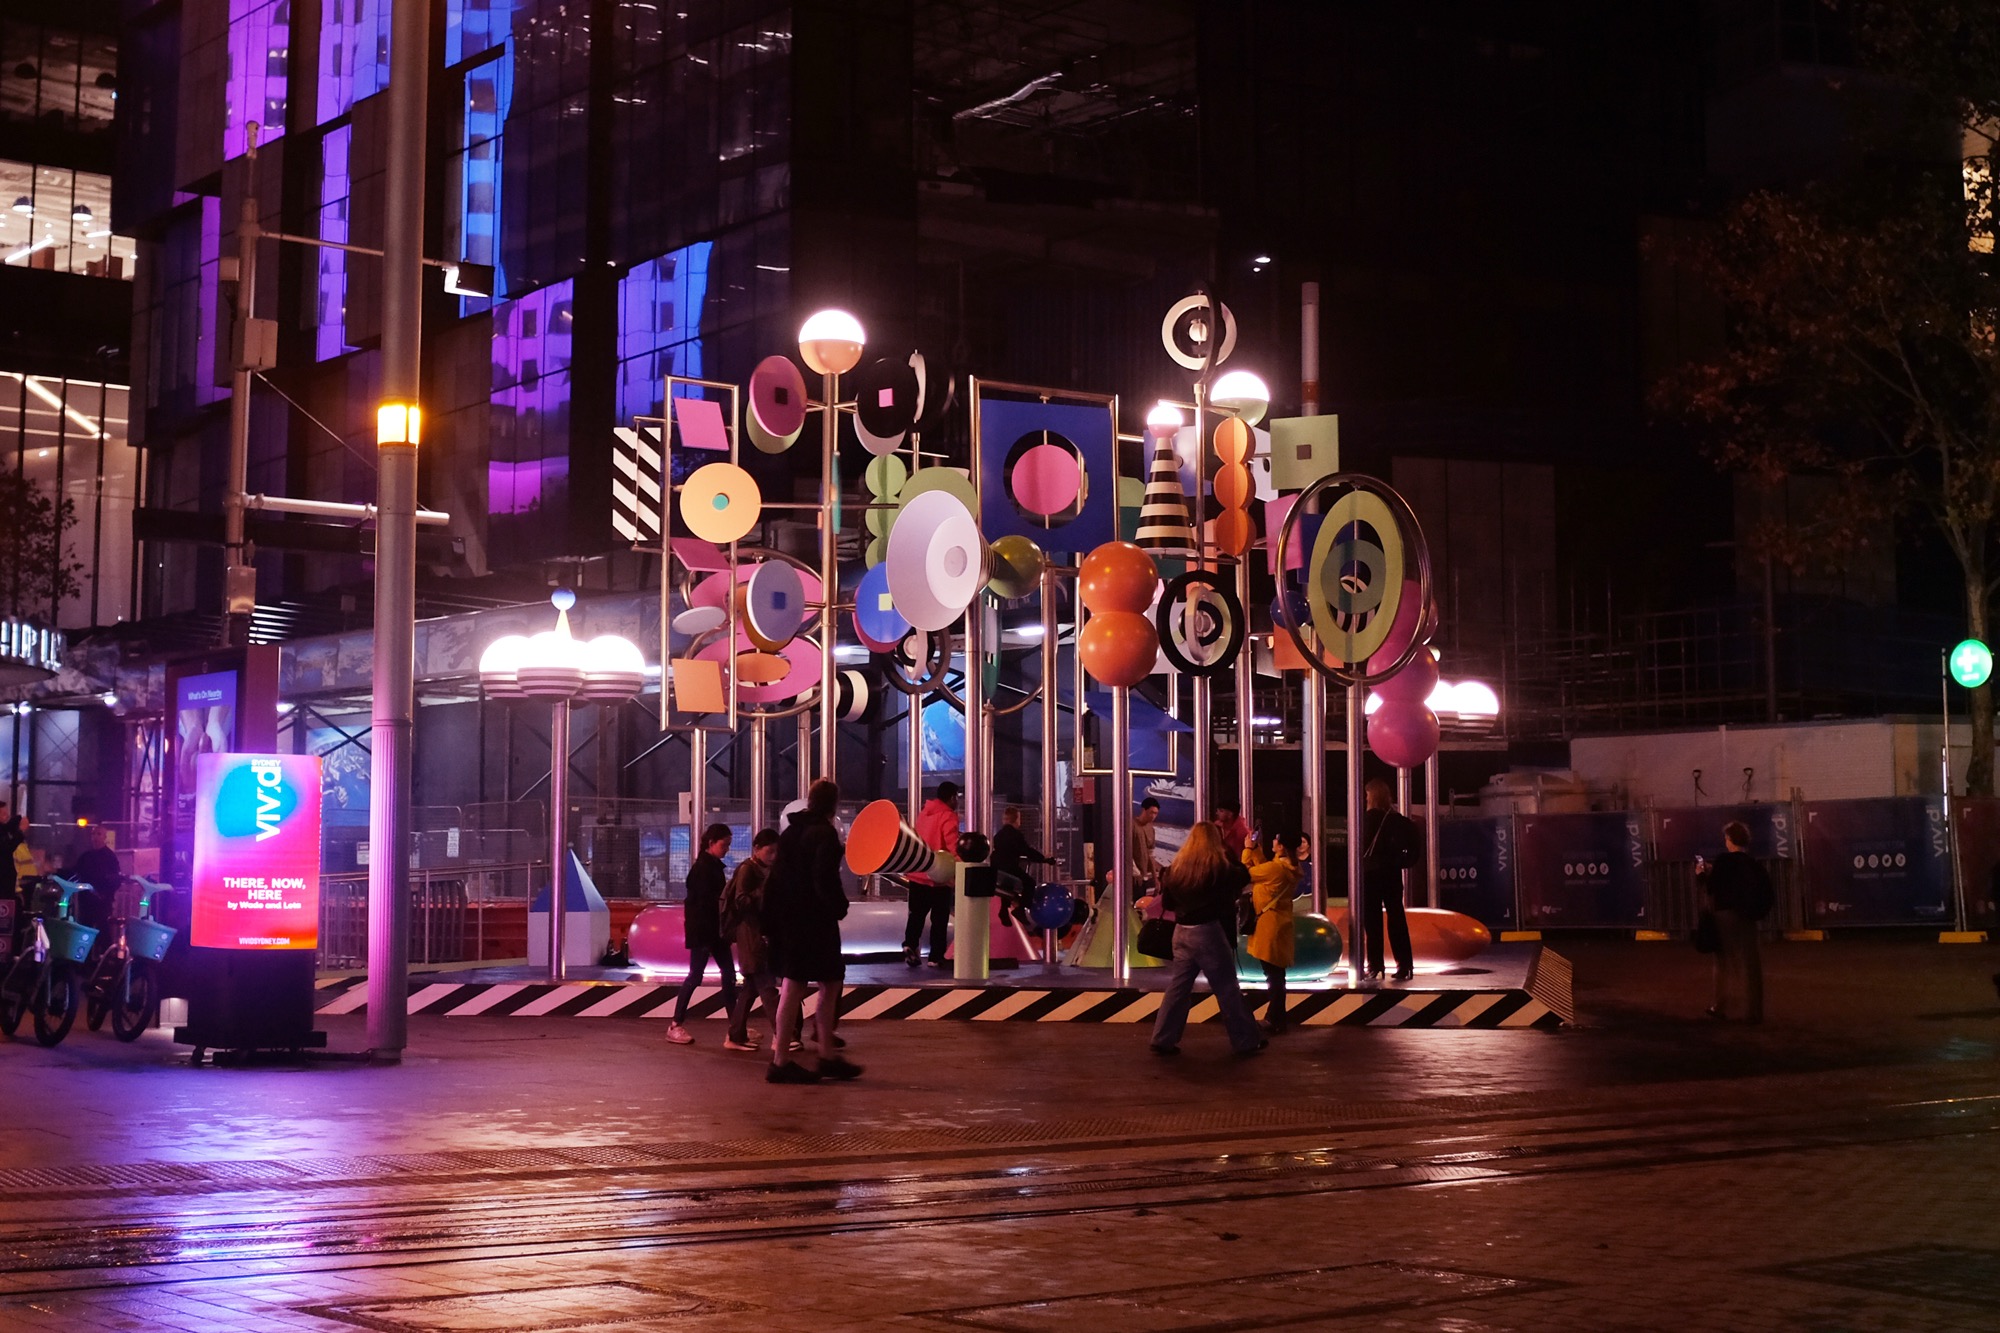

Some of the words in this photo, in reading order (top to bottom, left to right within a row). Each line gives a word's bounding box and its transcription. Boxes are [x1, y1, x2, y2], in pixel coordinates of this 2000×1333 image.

[223, 877, 268, 889] THERE,
[271, 878, 306, 890] NOW,
[248, 889, 282, 900] HERE
[227, 901, 238, 910] by
